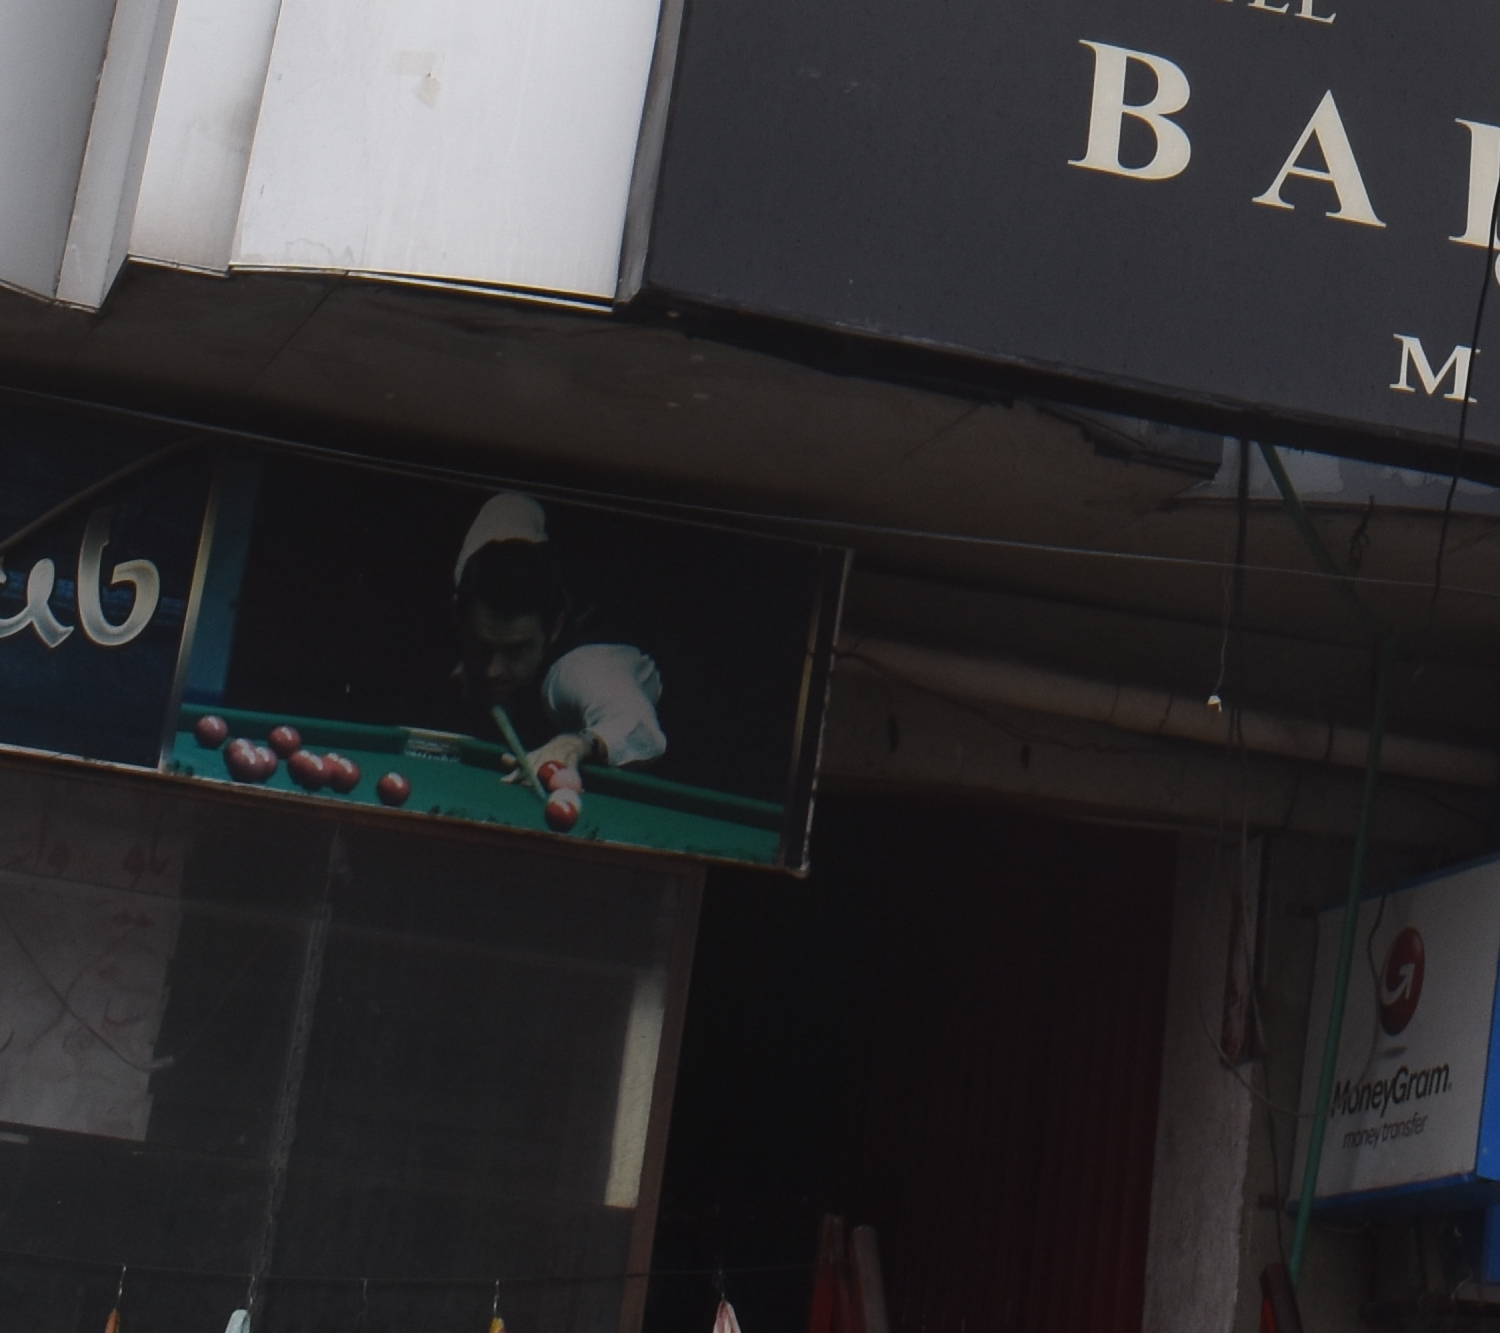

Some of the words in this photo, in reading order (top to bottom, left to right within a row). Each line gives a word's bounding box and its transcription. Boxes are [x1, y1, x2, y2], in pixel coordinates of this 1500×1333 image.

[1331, 1063, 1450, 1118] MoneyGram
[1342, 1125, 1383, 1149] money
[1381, 1112, 1429, 1142] transfer
